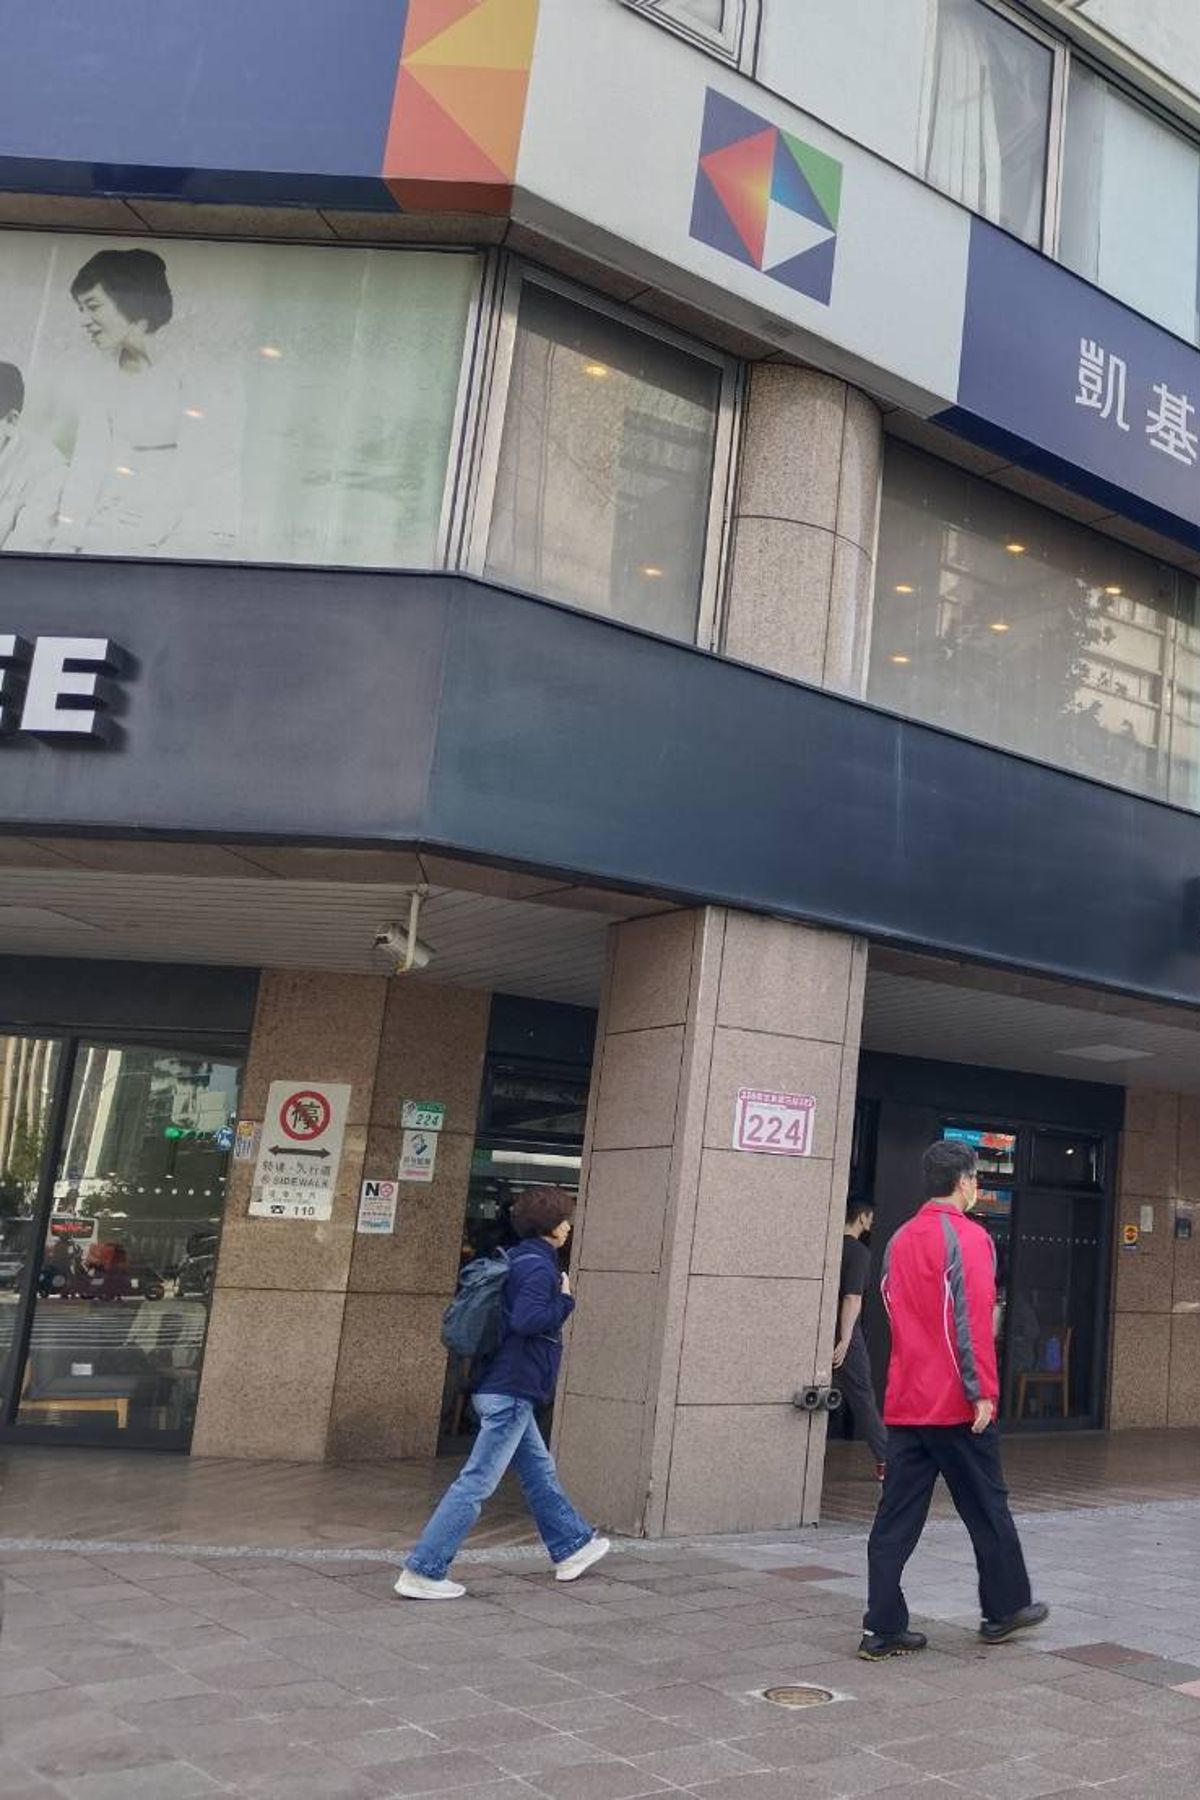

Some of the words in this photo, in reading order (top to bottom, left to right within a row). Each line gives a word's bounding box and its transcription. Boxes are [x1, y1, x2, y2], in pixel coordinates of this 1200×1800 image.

[416, 1113, 440, 1126] 224
[746, 1114, 802, 1146] 224
[273, 1176, 329, 1188] SIDEWALK
[293, 1205, 315, 1216] 110
